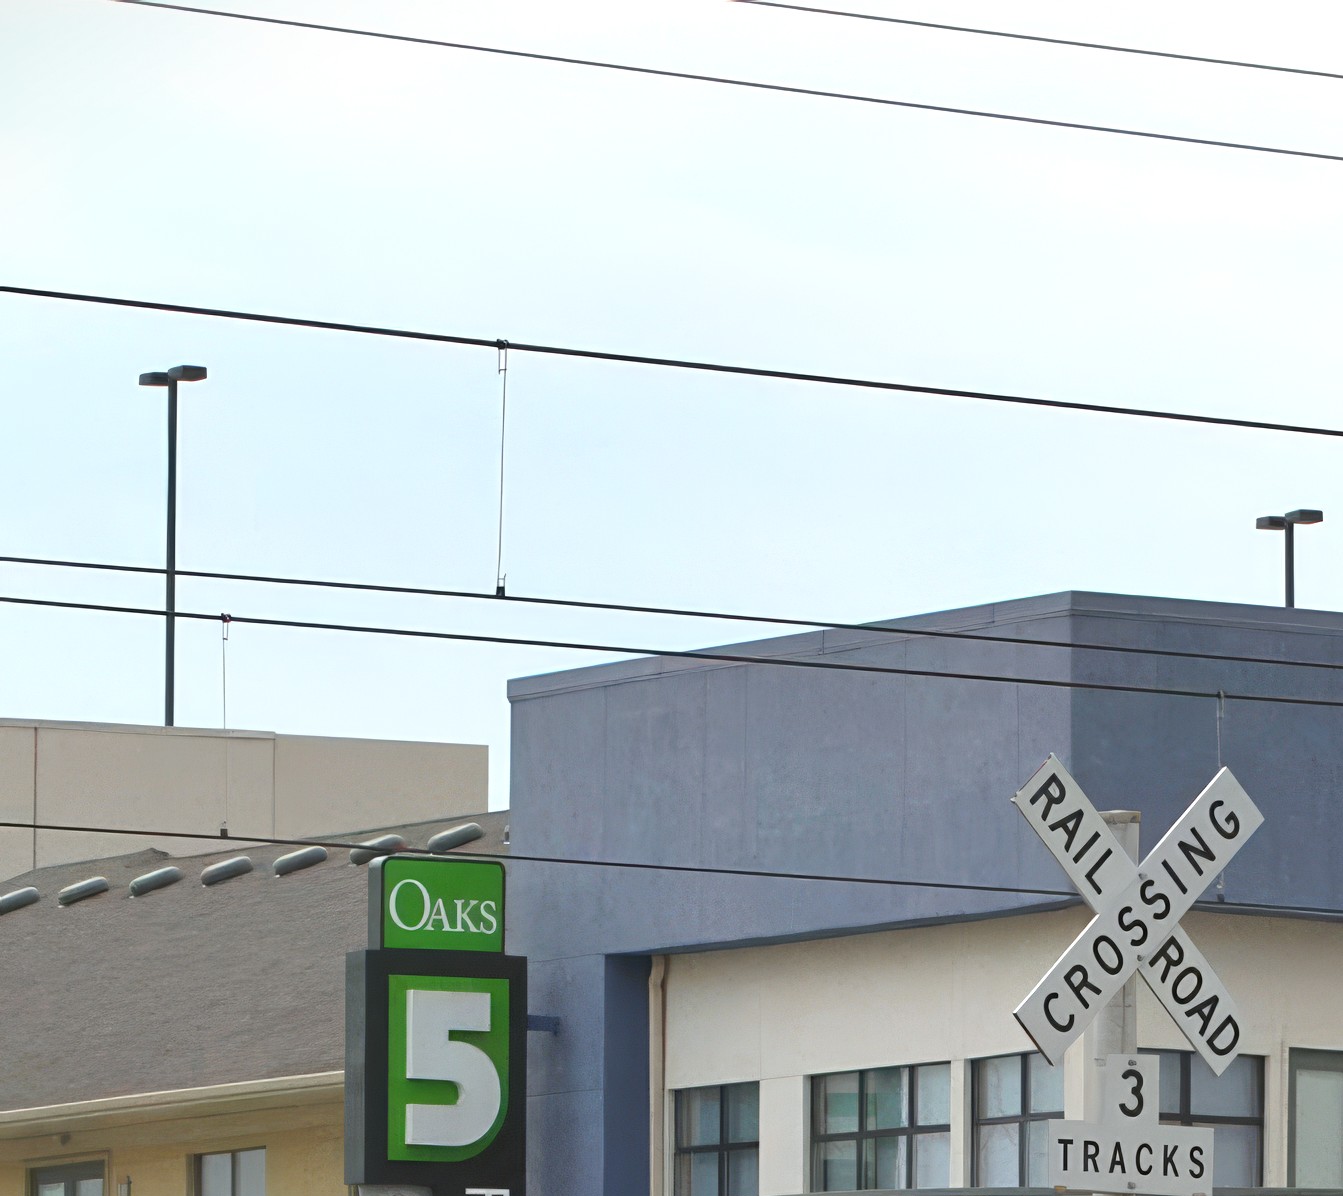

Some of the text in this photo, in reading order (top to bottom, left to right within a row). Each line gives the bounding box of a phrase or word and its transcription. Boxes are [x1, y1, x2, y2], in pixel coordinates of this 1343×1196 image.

[1029, 772, 1240, 1056] RAIL ROAD
[1043, 800, 1240, 1033] CROSSING
[405, 989, 501, 1147] 5
[1118, 1068, 1144, 1118] 3
[1057, 1138, 1205, 1179] TRACKS
